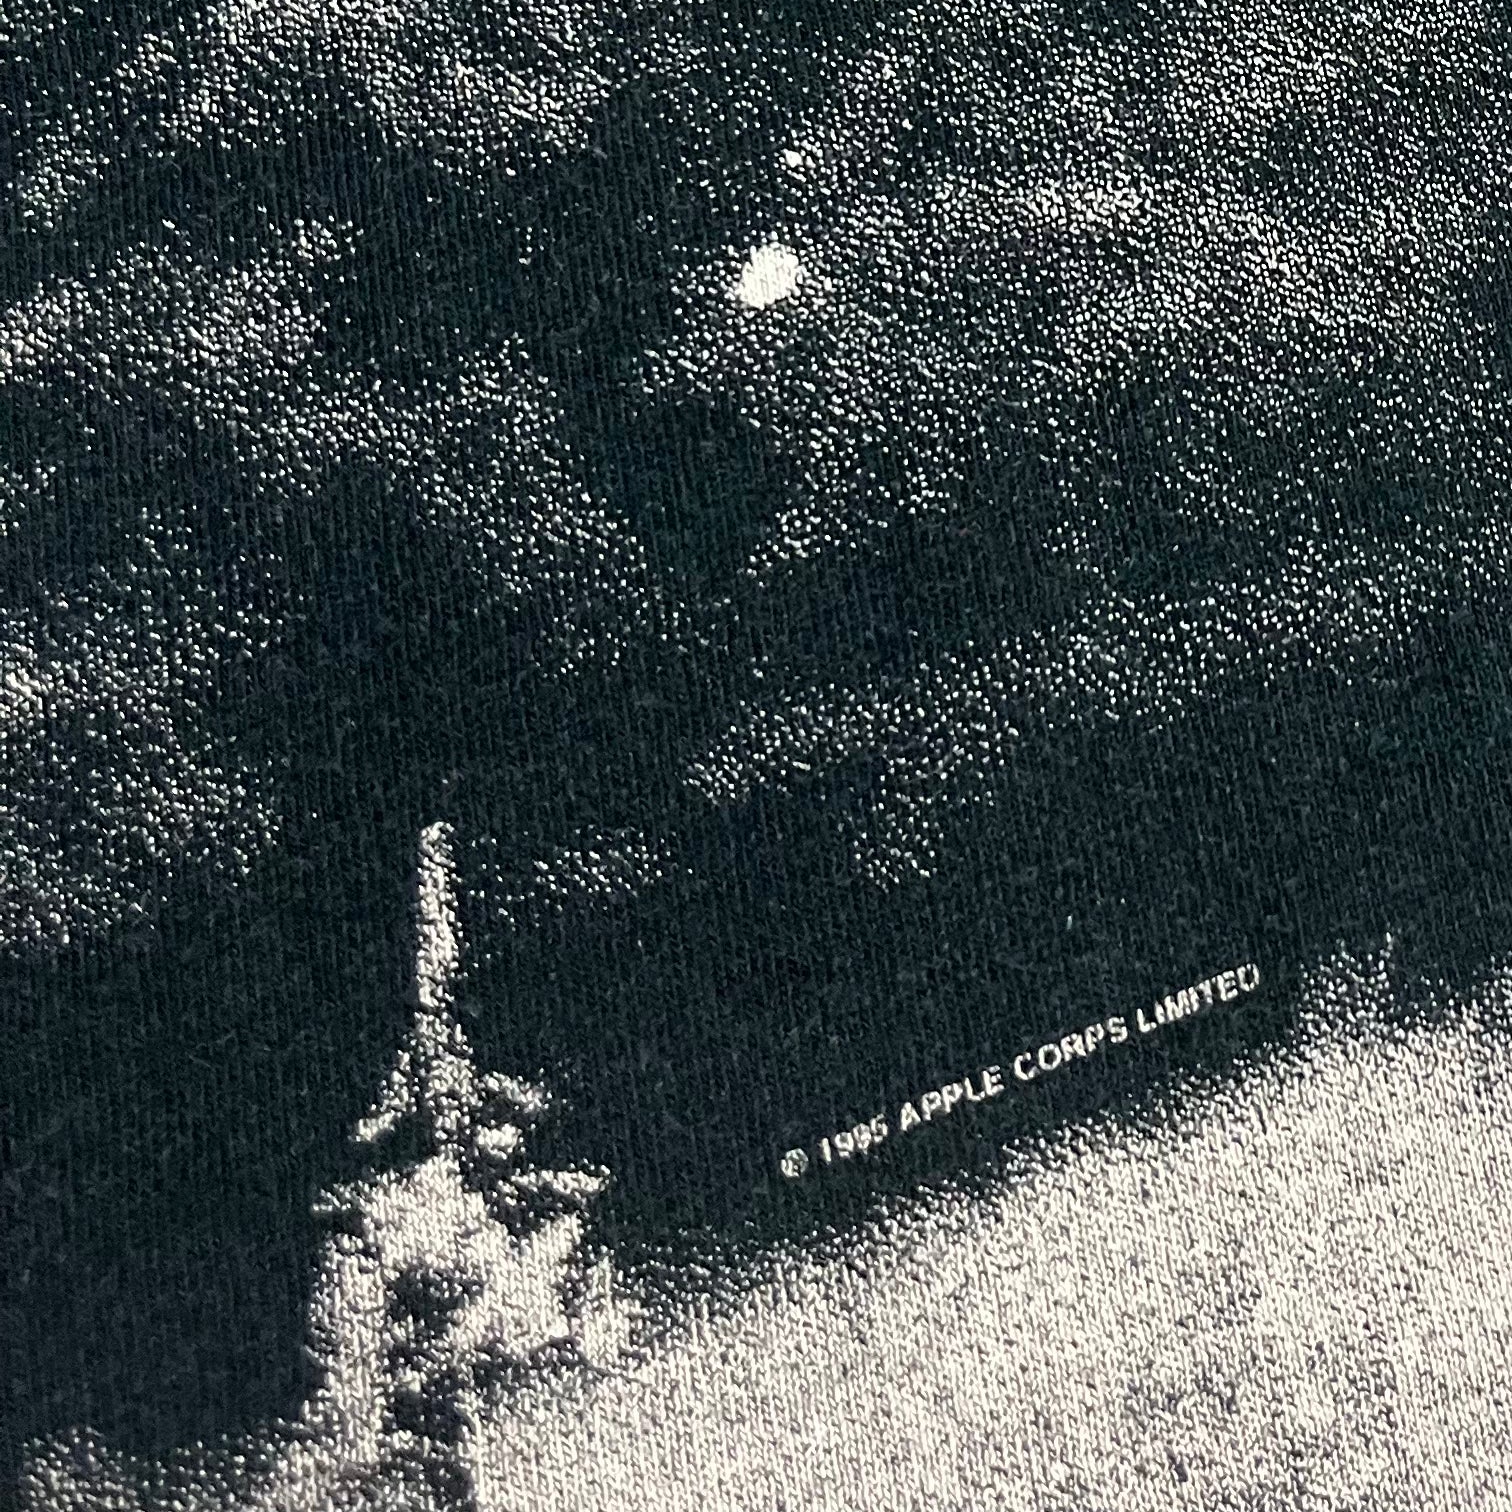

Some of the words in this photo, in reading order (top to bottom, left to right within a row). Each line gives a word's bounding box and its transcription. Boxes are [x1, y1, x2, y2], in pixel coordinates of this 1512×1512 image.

[900, 1064, 1005, 1132] APPLE
[1013, 1015, 1129, 1081] CORPS
[1136, 962, 1260, 1033] LIMITED
